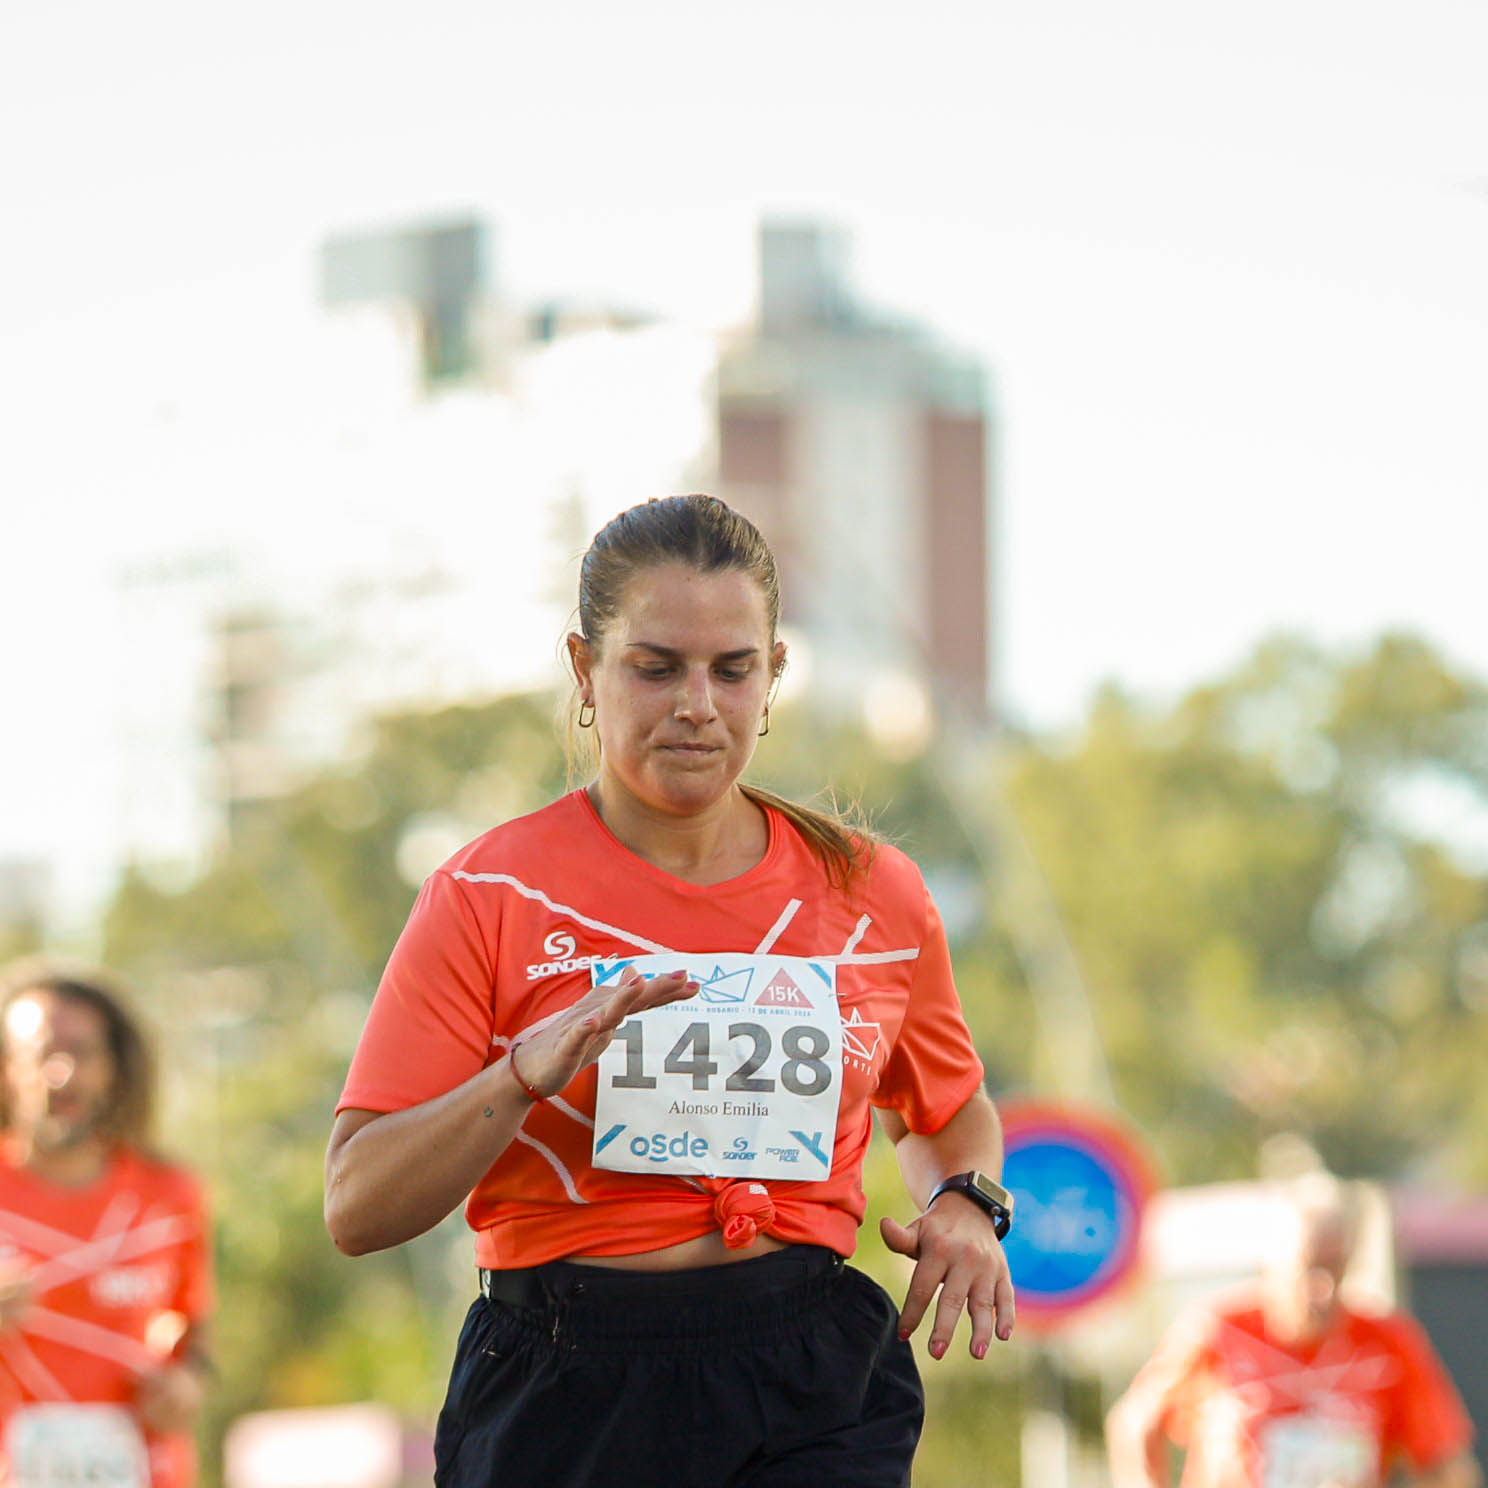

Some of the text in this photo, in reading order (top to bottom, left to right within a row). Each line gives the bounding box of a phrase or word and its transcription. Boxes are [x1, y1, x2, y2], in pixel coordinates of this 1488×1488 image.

[768, 986, 800, 1003] 15K
[612, 1020, 832, 1096] 1428
[669, 1100, 769, 1116] Alonso Emilia
[630, 1131, 709, 1158] osde
